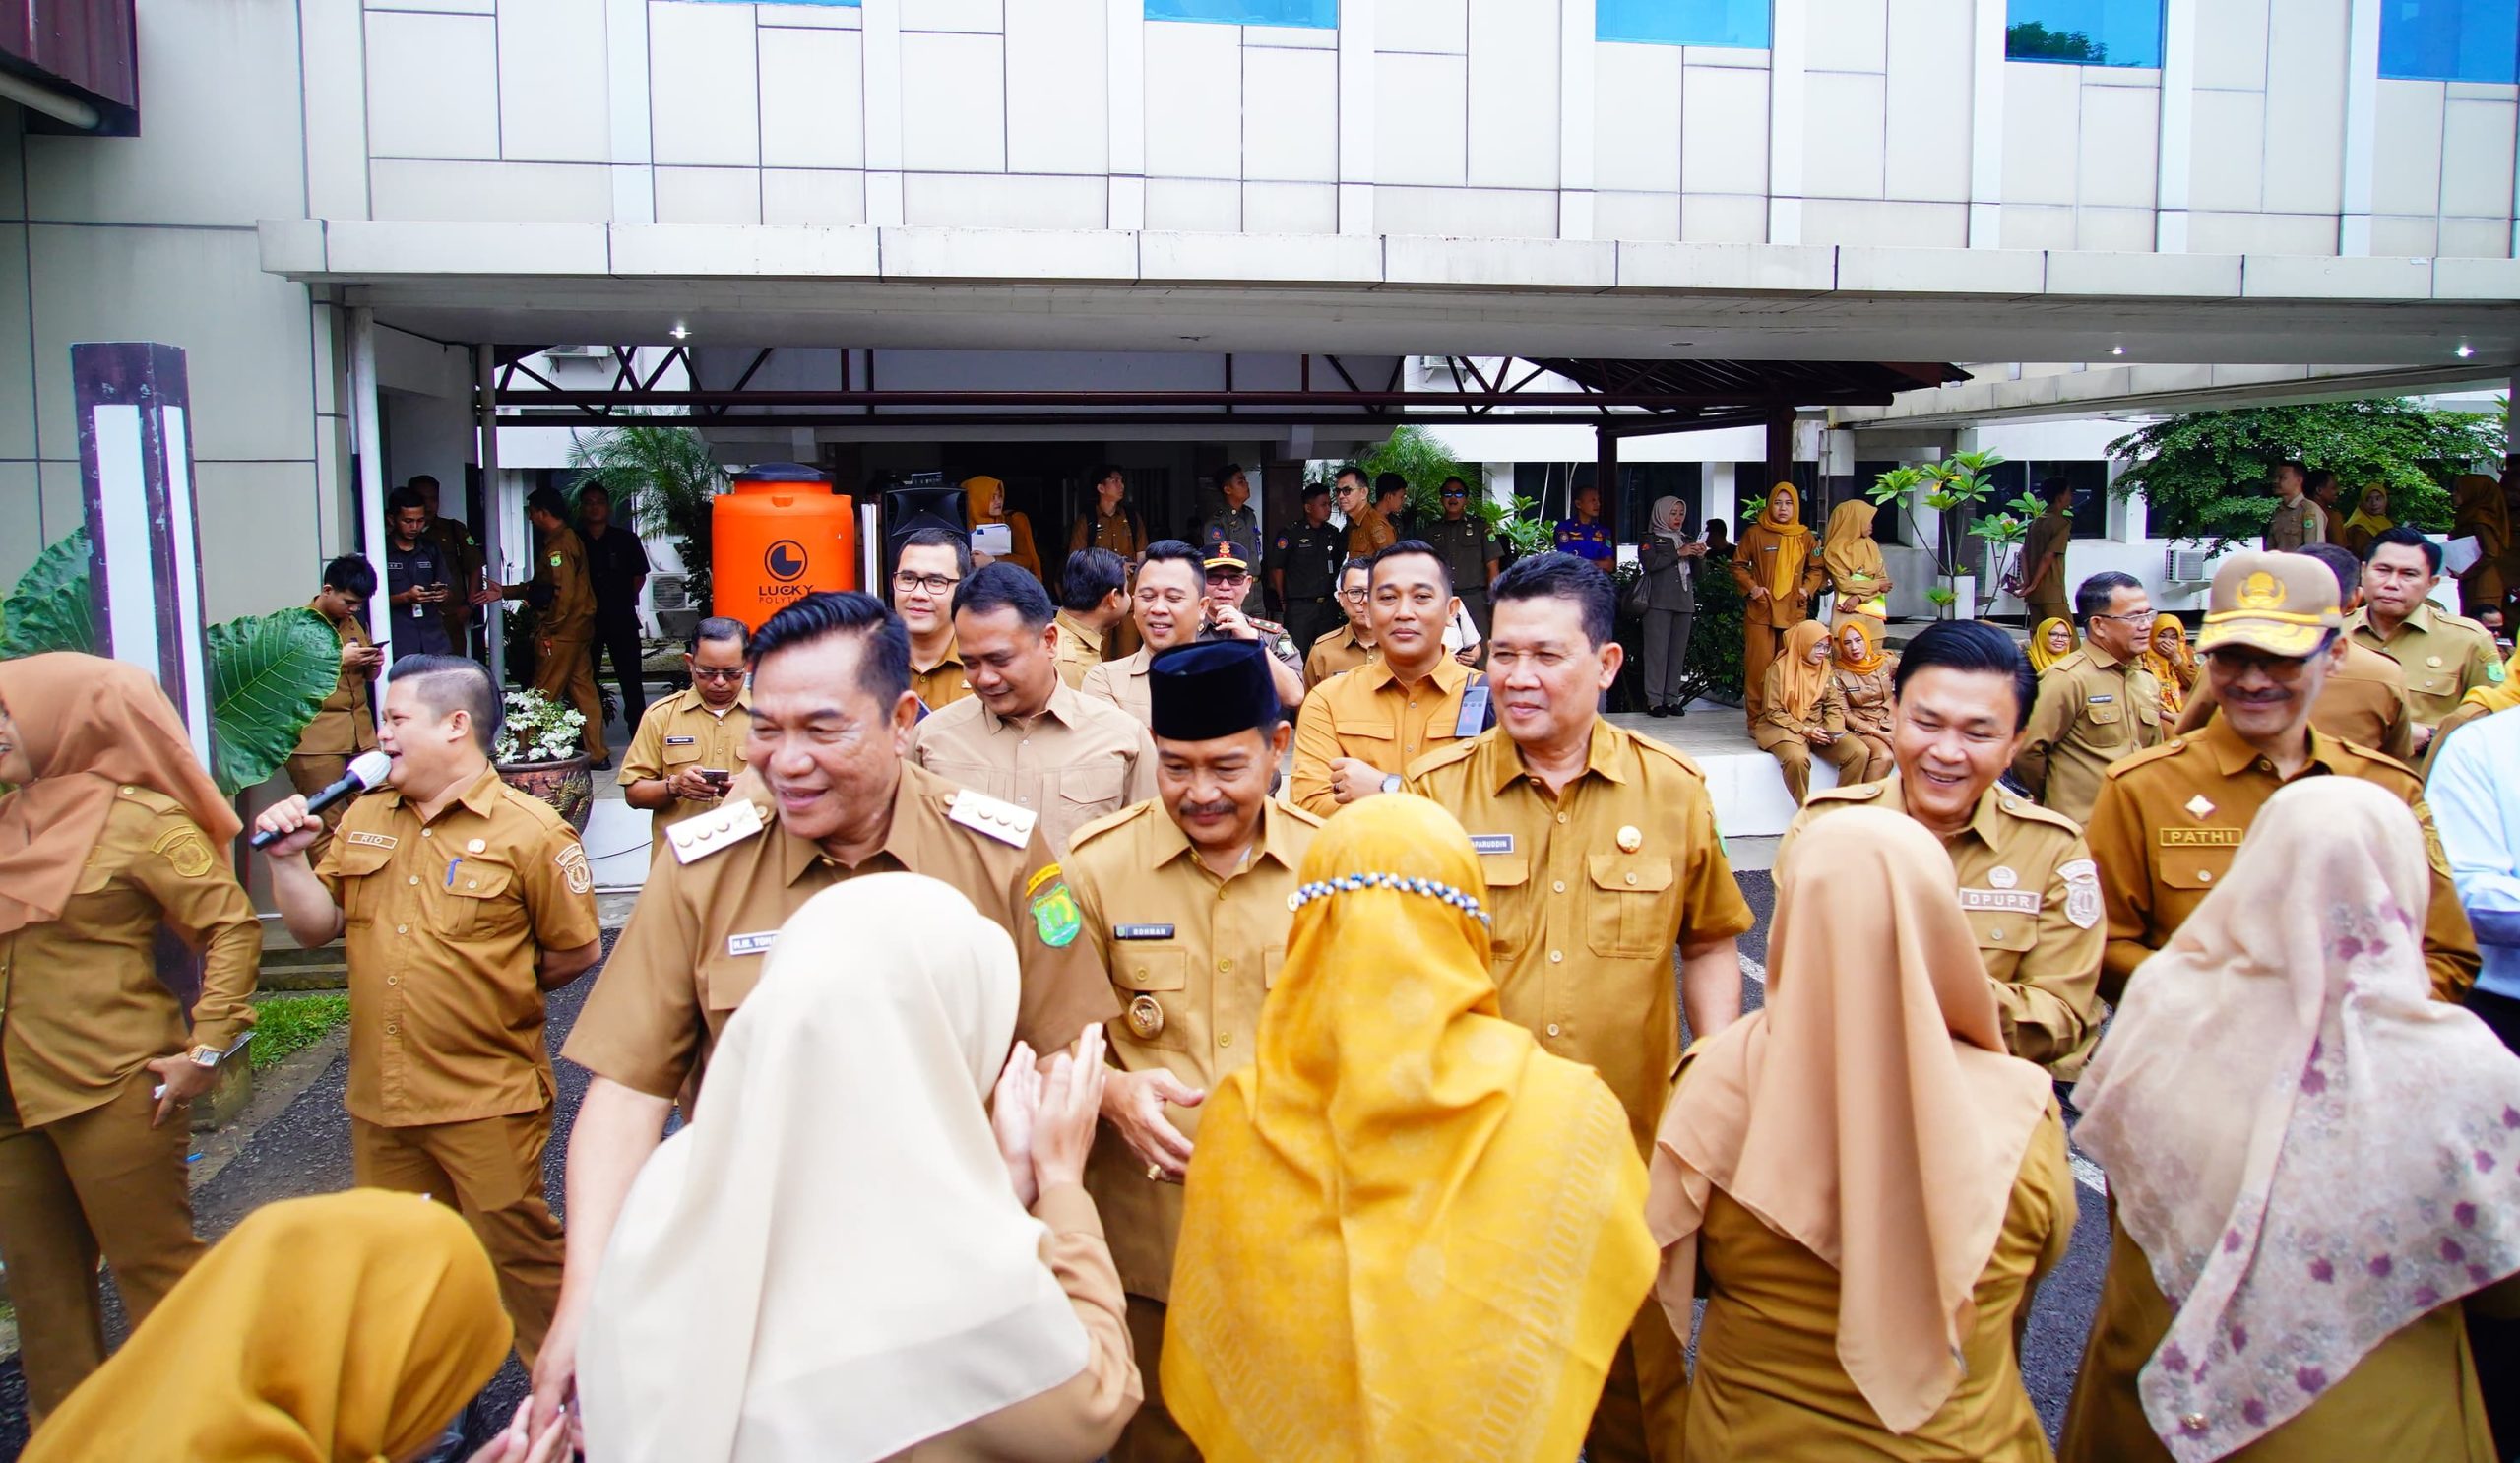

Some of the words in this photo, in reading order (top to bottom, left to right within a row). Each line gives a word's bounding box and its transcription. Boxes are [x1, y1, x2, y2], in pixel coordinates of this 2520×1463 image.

[758, 584, 814, 596] LUCKY
[360, 835, 384, 844] RIO
[2171, 831, 2232, 843] PATHI
[1969, 893, 2031, 908] DPUPR
[1132, 927, 1166, 936] ROHMAN
